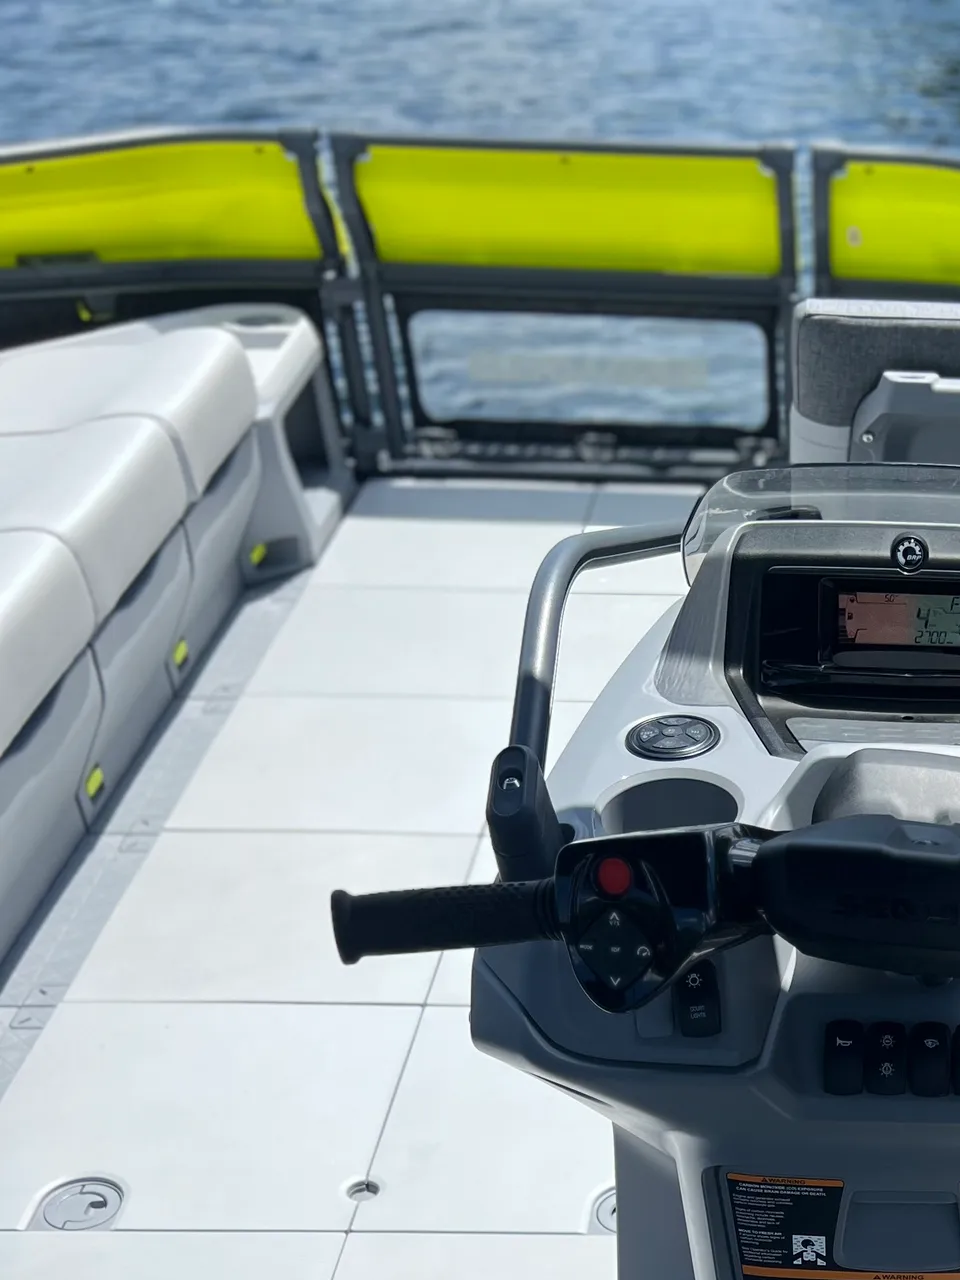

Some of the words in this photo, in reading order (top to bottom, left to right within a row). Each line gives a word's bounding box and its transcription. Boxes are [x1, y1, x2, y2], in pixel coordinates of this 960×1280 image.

[950, 596, 960, 612] F
[916, 607, 930, 630] 4
[914, 631, 947, 645] 2700
[768, 1177, 806, 1185] WARNING
